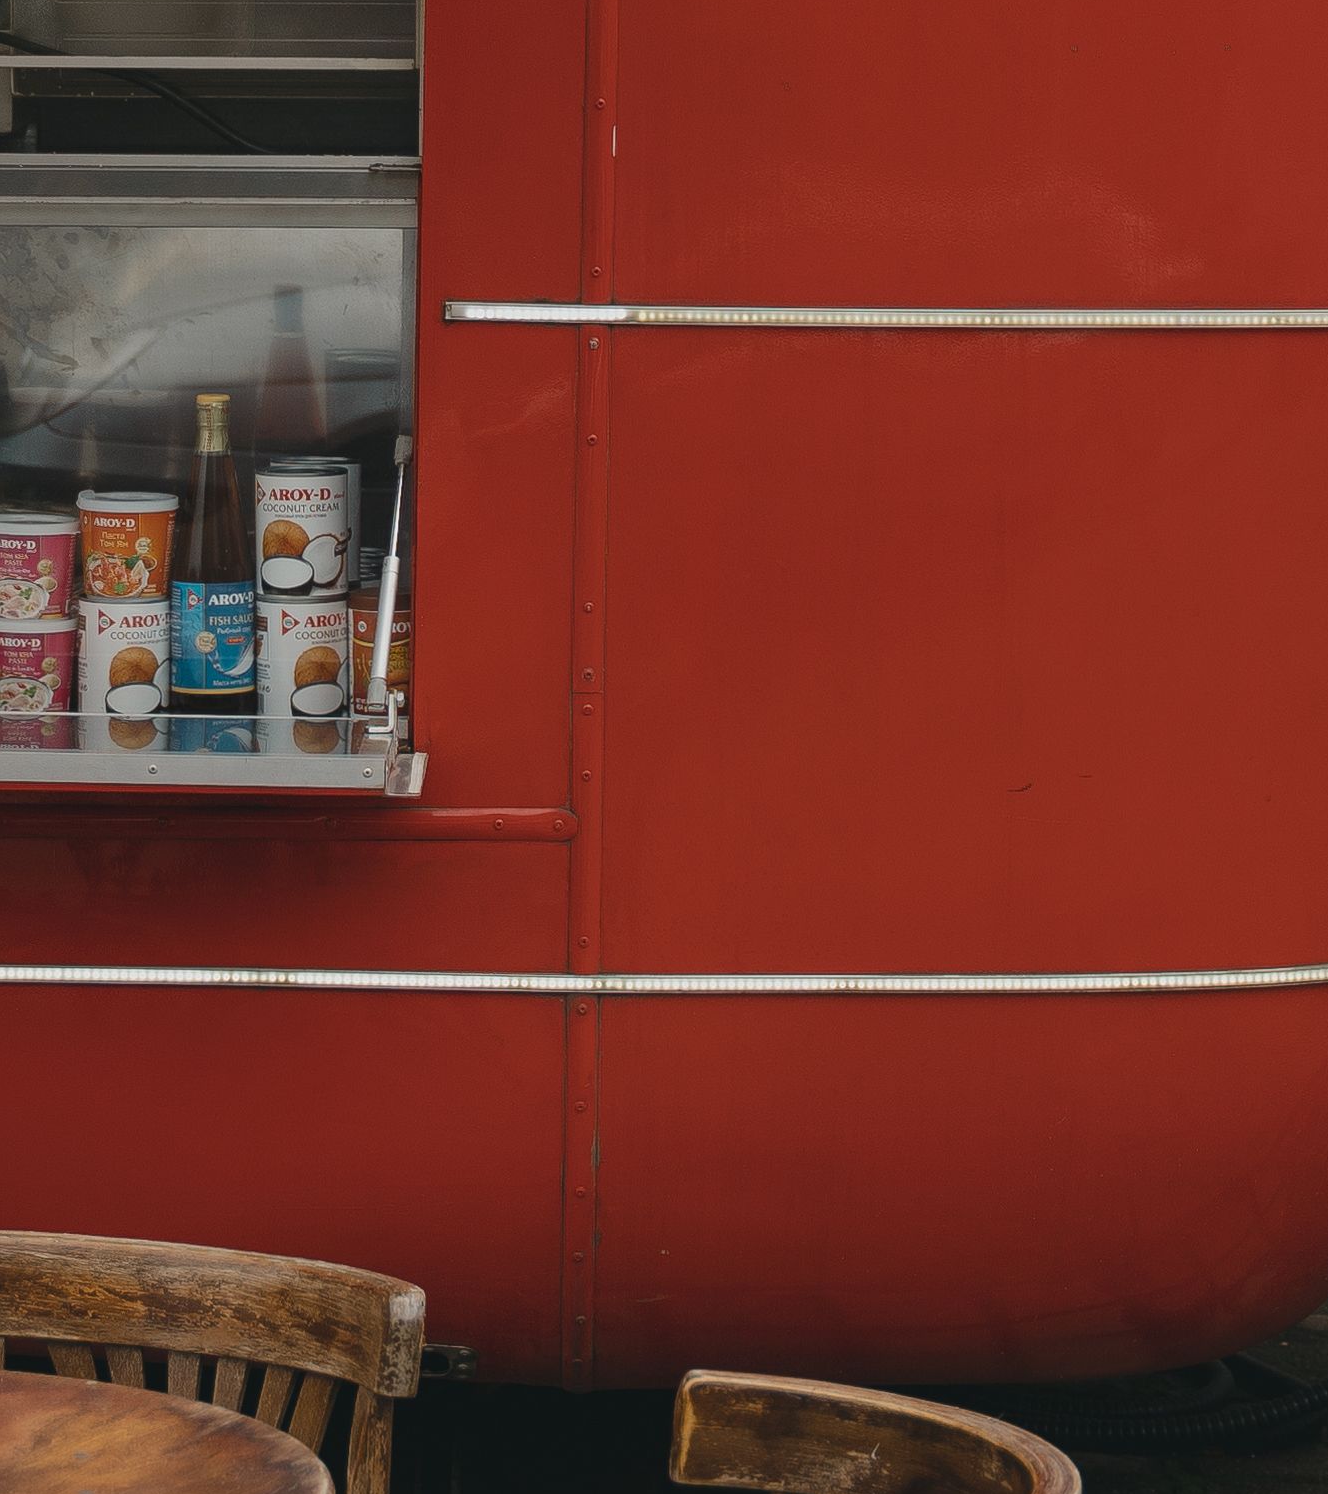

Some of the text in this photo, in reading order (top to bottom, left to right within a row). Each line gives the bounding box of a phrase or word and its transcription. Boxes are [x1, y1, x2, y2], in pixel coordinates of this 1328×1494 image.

[269, 488, 331, 501] AROY-D
[262, 503, 340, 513] COCONUT CREAM
[94, 517, 136, 528] AROY-D
[209, 616, 231, 626] FISH
[110, 630, 158, 640] COCONUT
[295, 629, 339, 640] COCONUT
